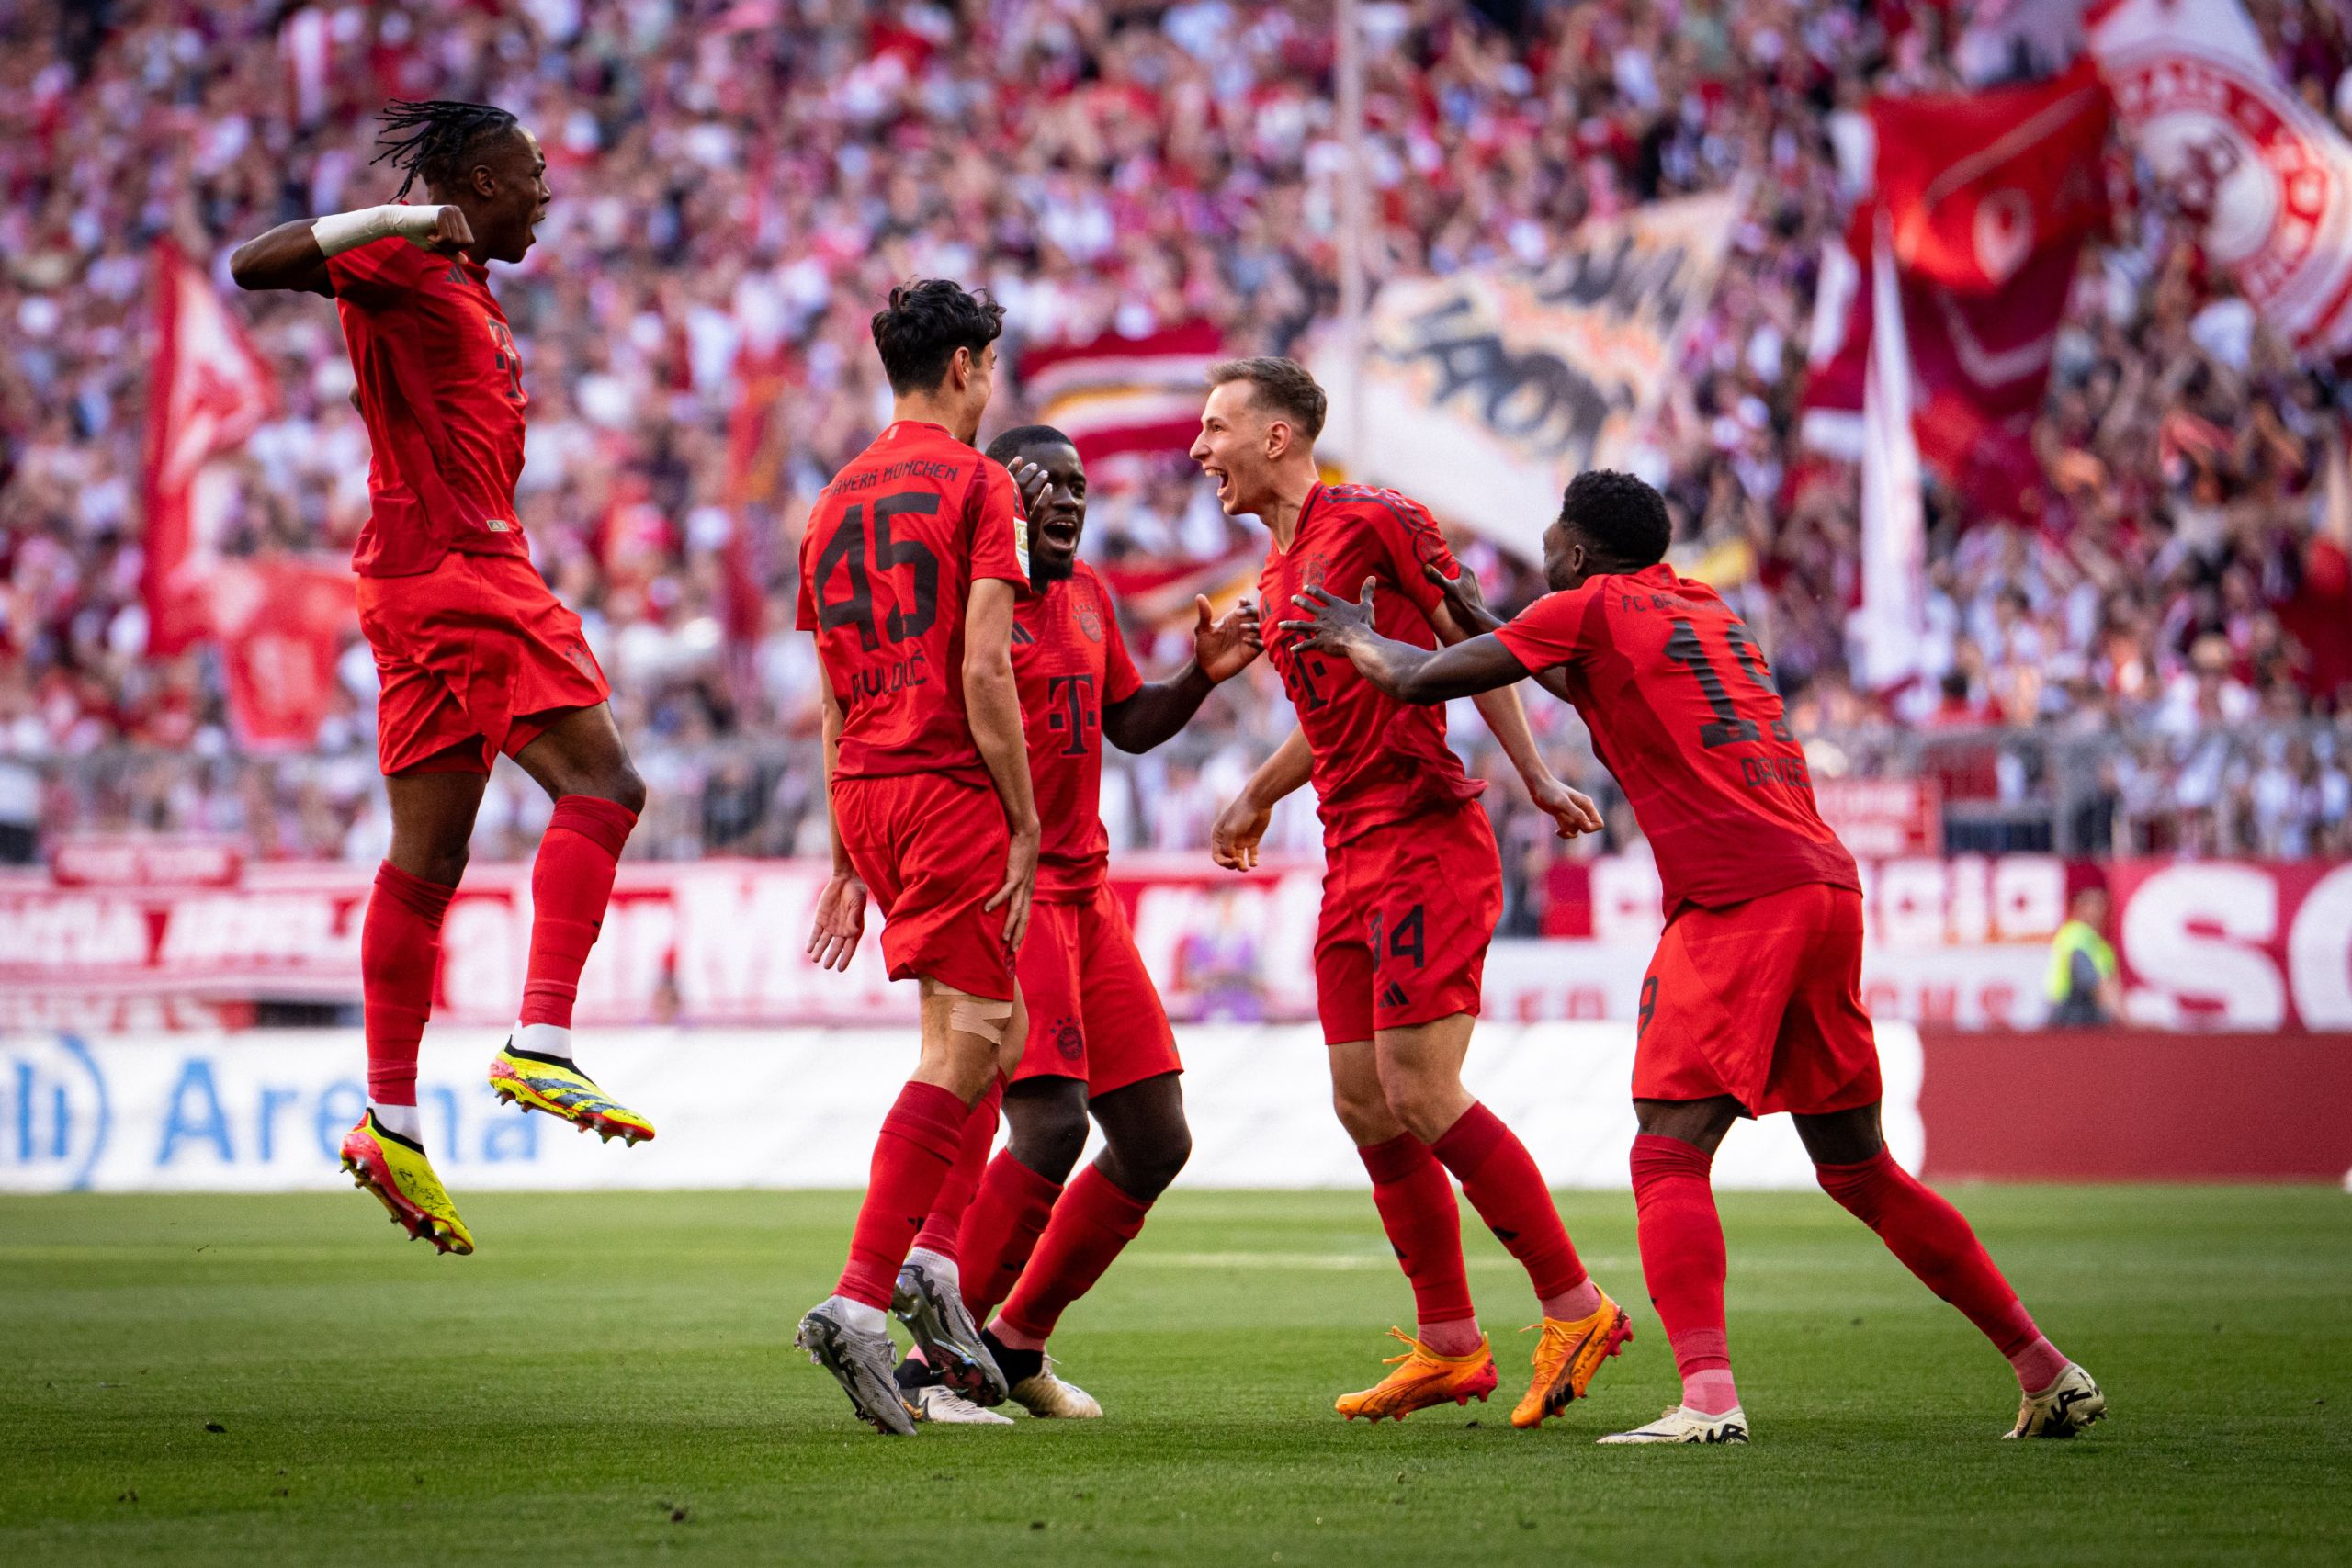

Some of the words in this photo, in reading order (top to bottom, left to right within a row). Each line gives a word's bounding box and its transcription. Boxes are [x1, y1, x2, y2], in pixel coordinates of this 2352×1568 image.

[830, 468, 878, 499] AYERN
[814, 491, 941, 652] 45
[1739, 756, 1812, 788] DAVIE
[1368, 904, 1424, 975] 14
[156, 1057, 540, 1165] Arena
